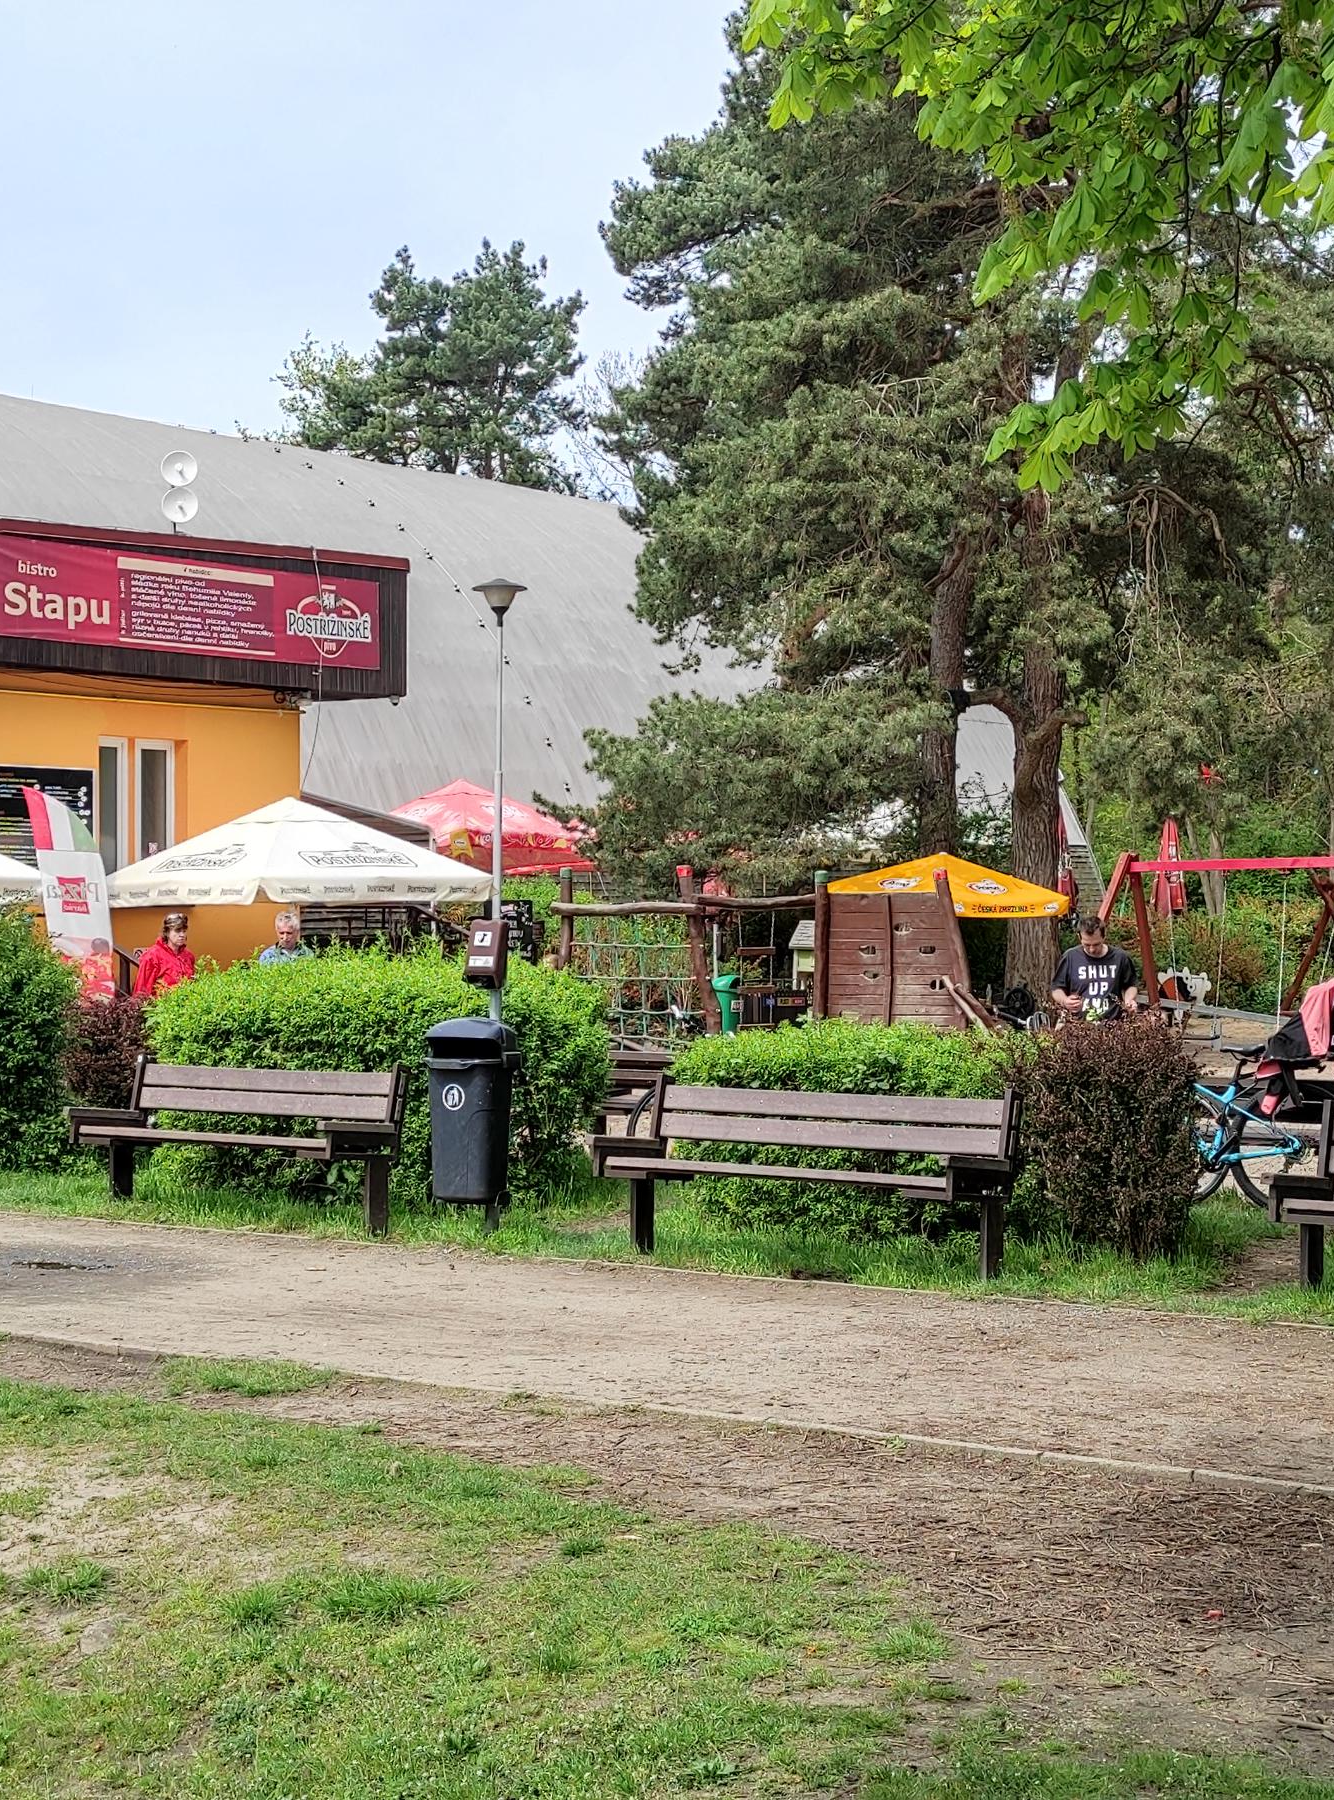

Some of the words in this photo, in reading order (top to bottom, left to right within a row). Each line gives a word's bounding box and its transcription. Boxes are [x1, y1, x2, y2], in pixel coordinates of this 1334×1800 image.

[18, 560, 57, 577] bistro
[4, 581, 110, 630] Stapu
[977, 903, 997, 913] ČESKÁ
[998, 904, 1030, 913] ZMRZLINA
[1078, 965, 1117, 979] SHUT
[1088, 982, 1108, 995] UP
